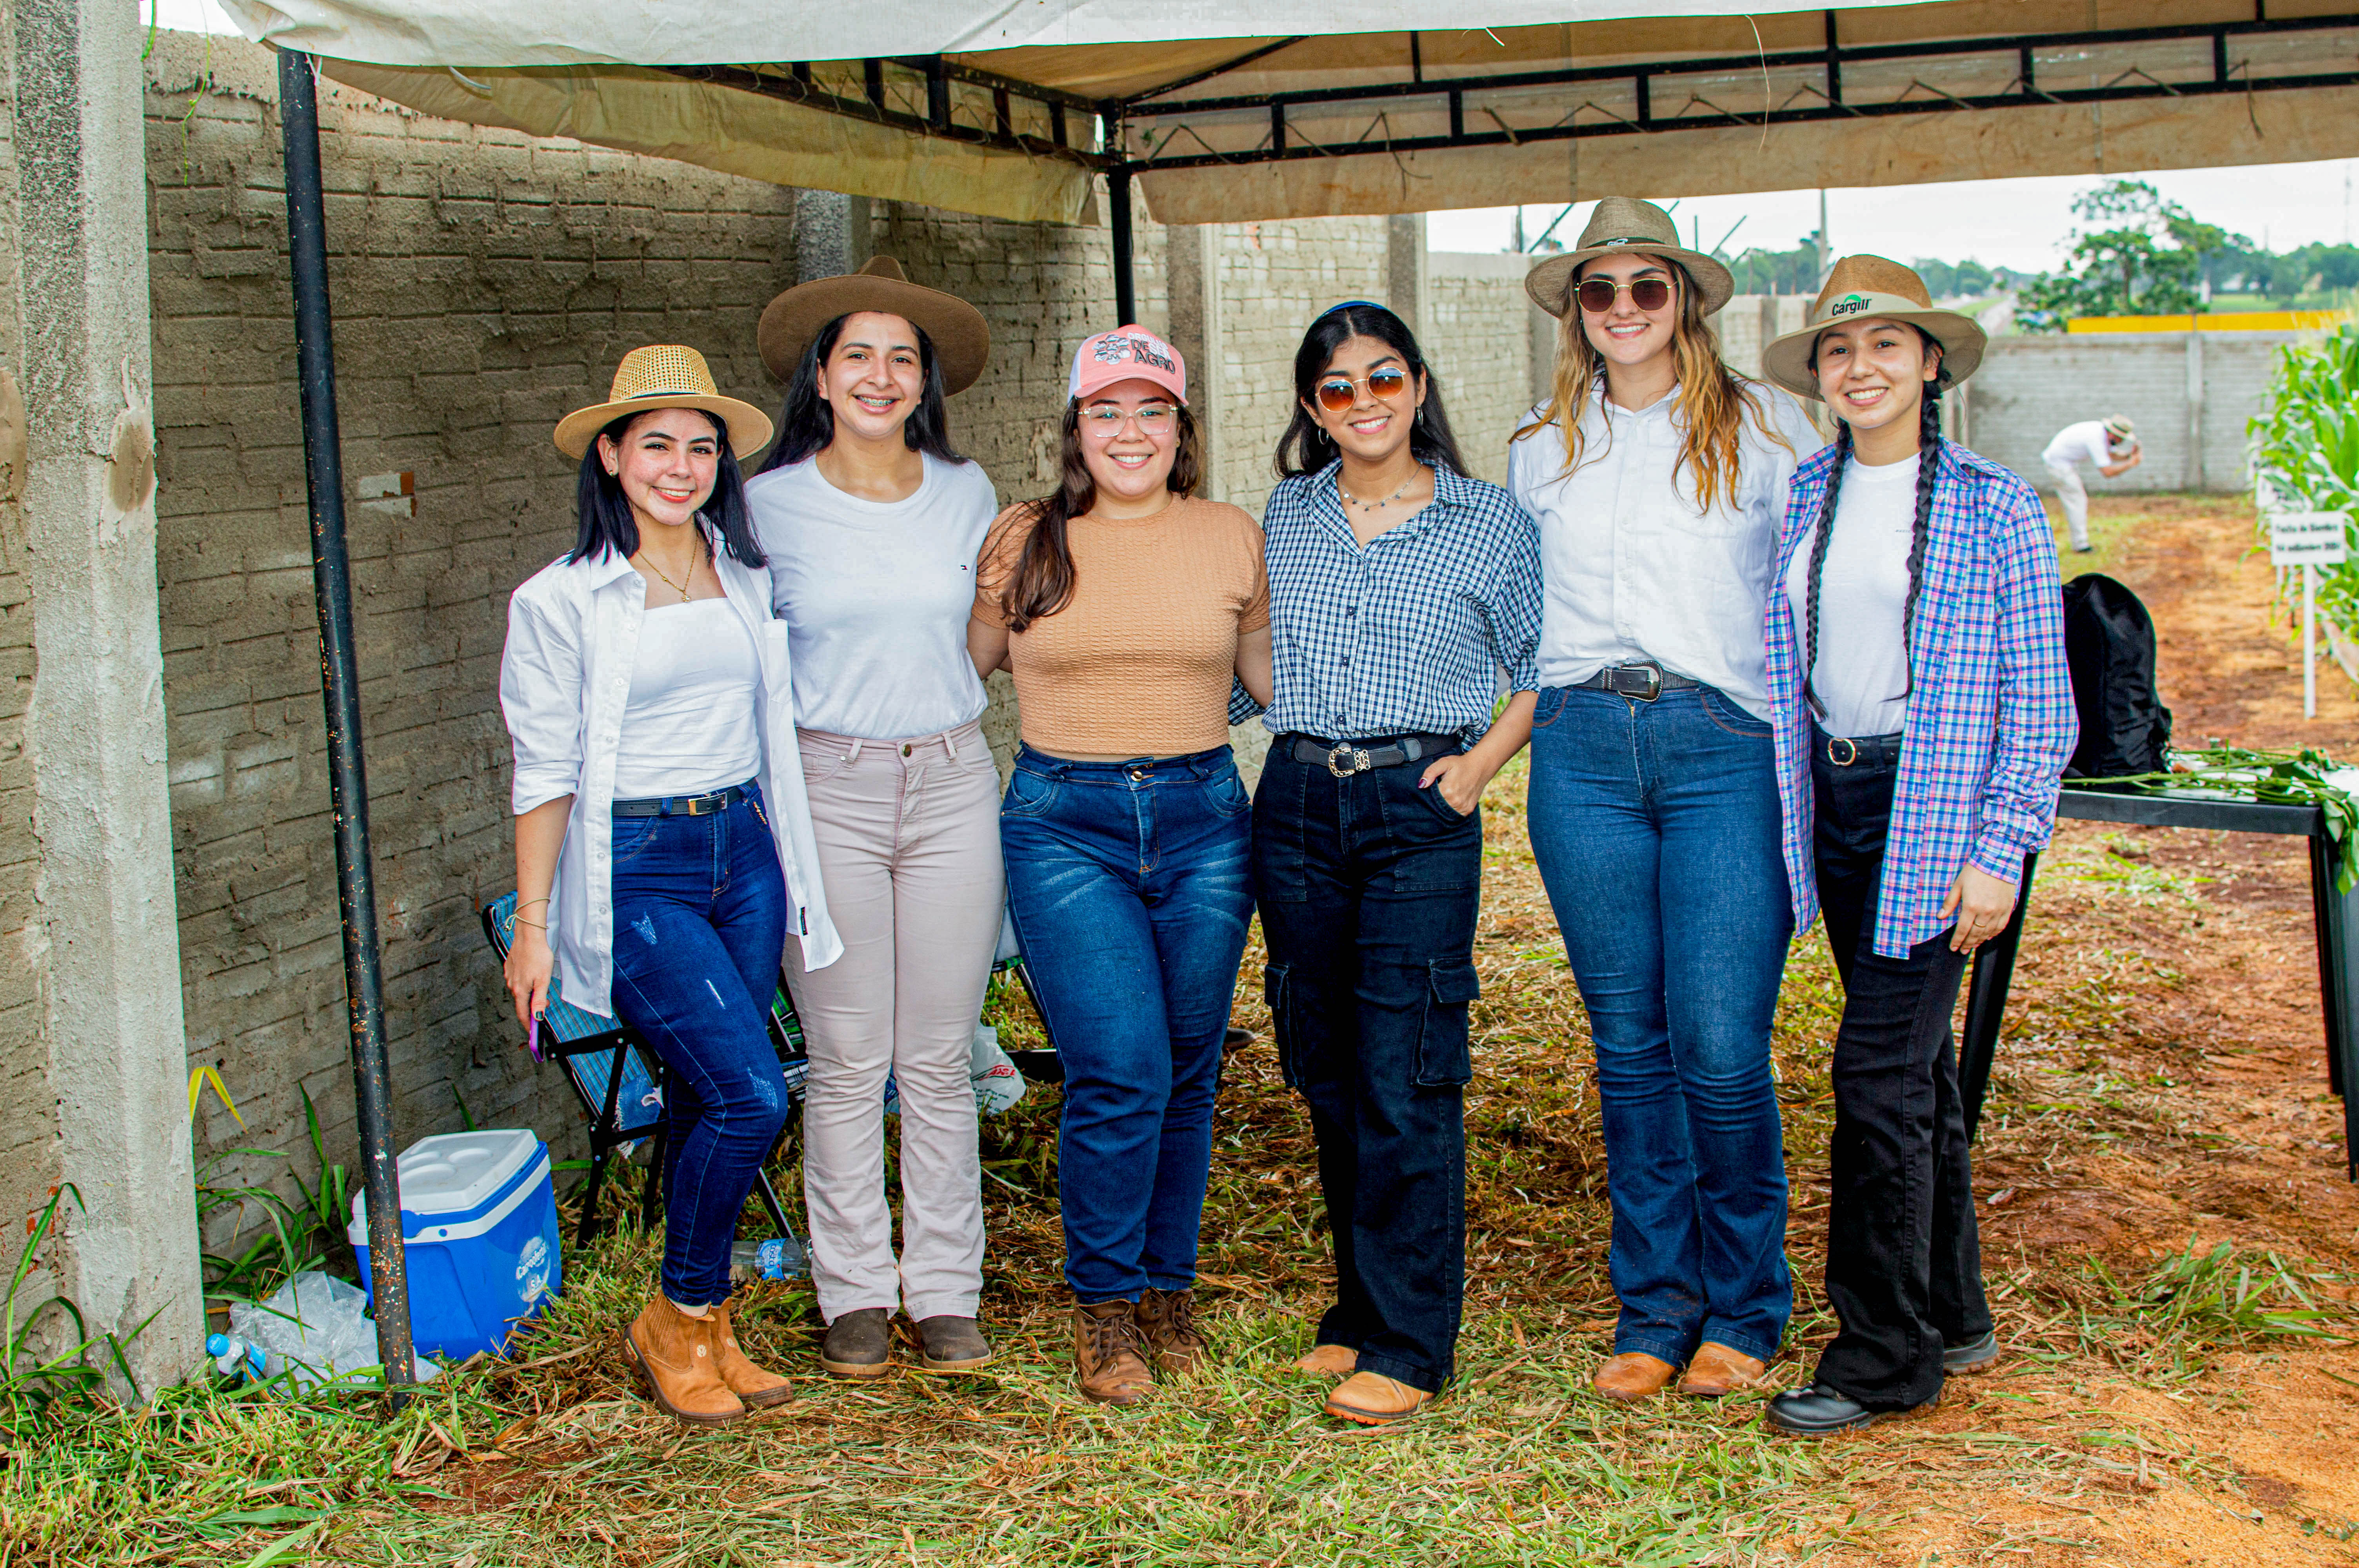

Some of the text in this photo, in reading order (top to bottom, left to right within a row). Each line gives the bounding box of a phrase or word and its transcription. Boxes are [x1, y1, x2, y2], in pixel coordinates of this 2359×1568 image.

[1832, 298, 1870, 316] Cargill
[1128, 332, 1168, 349] ORGULLO
[1132, 339, 1171, 359] DE SER
[1135, 350, 1175, 374] AGRO
